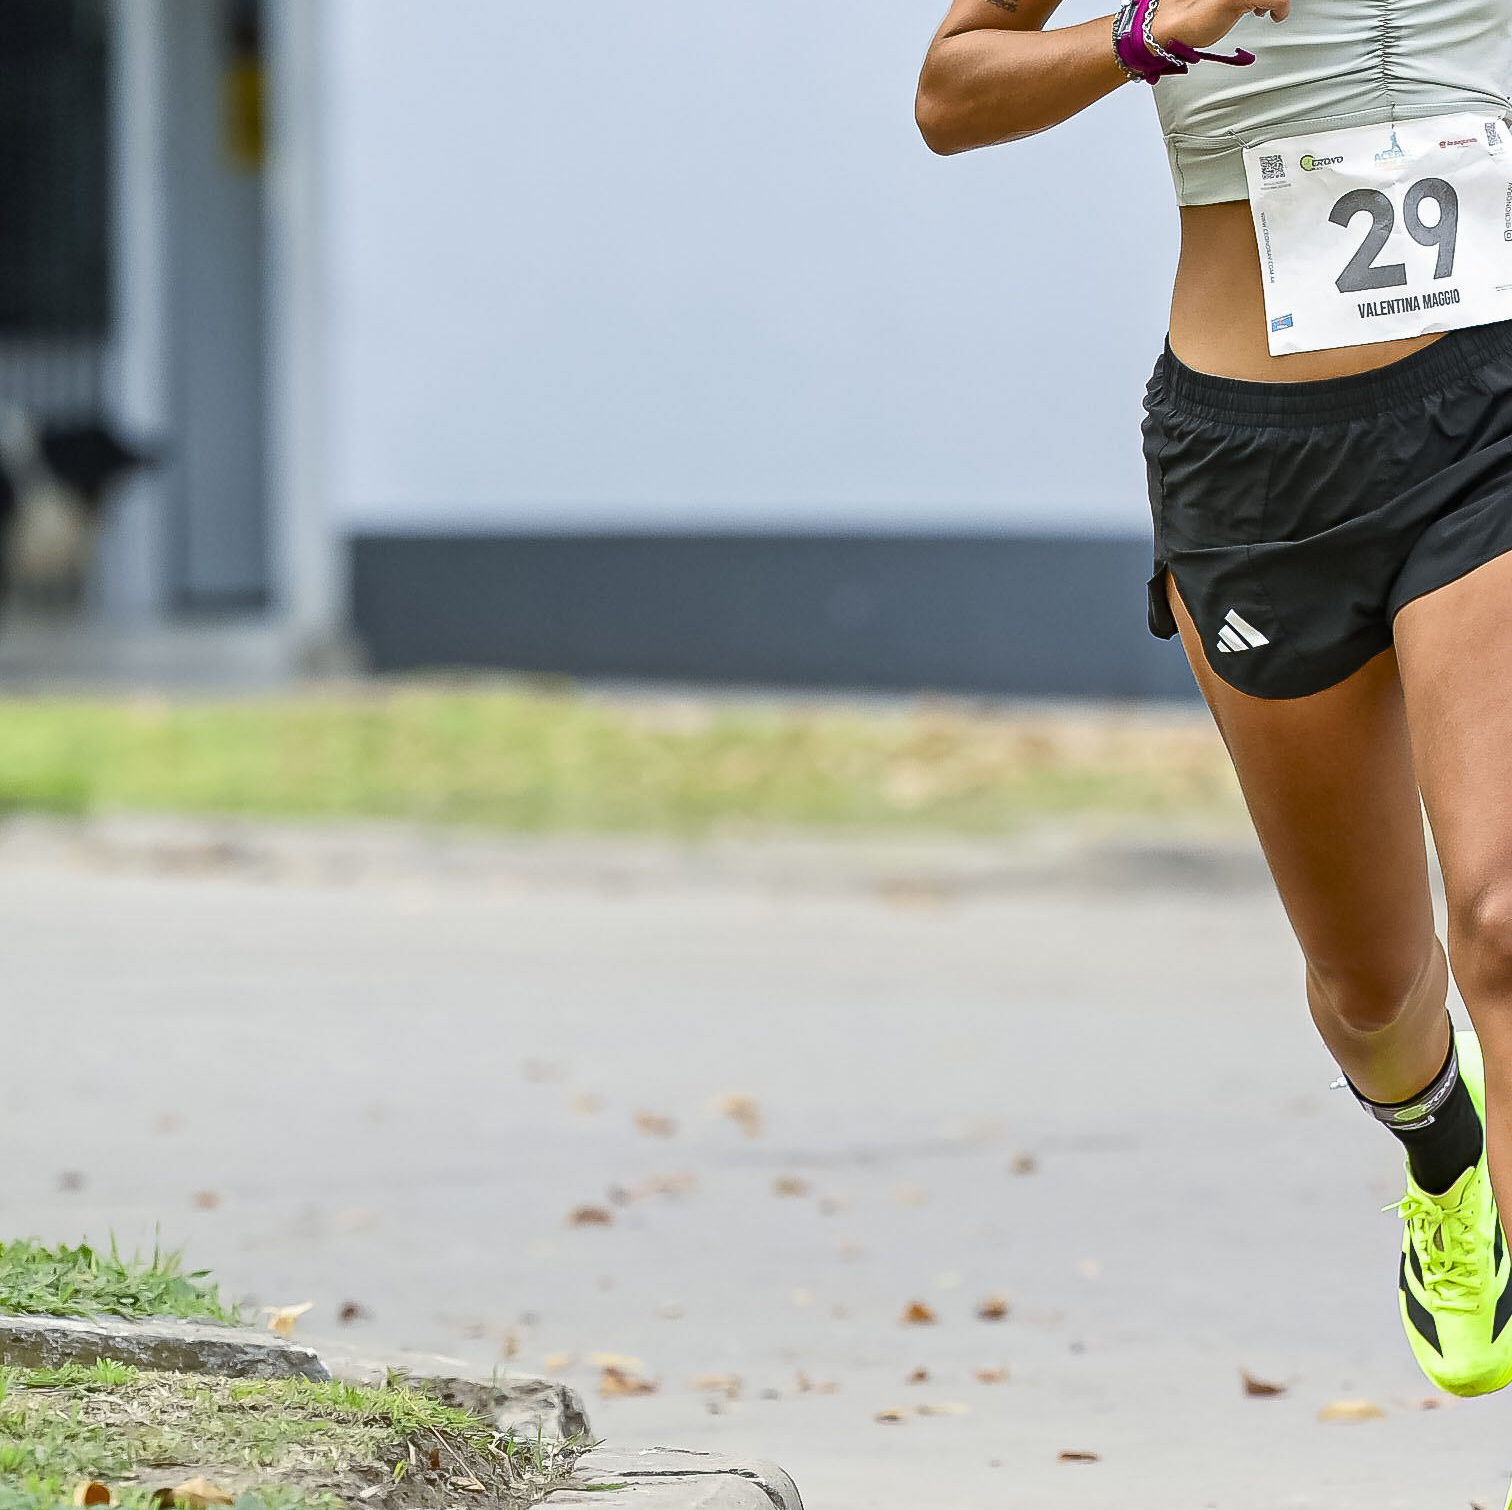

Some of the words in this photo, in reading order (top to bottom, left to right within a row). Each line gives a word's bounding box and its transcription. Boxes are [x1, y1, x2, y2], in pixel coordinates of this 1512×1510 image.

[1328, 177, 1458, 293] 29
[1357, 295, 1421, 319] VALENTINA
[1422, 288, 1460, 310] MAGGIO
